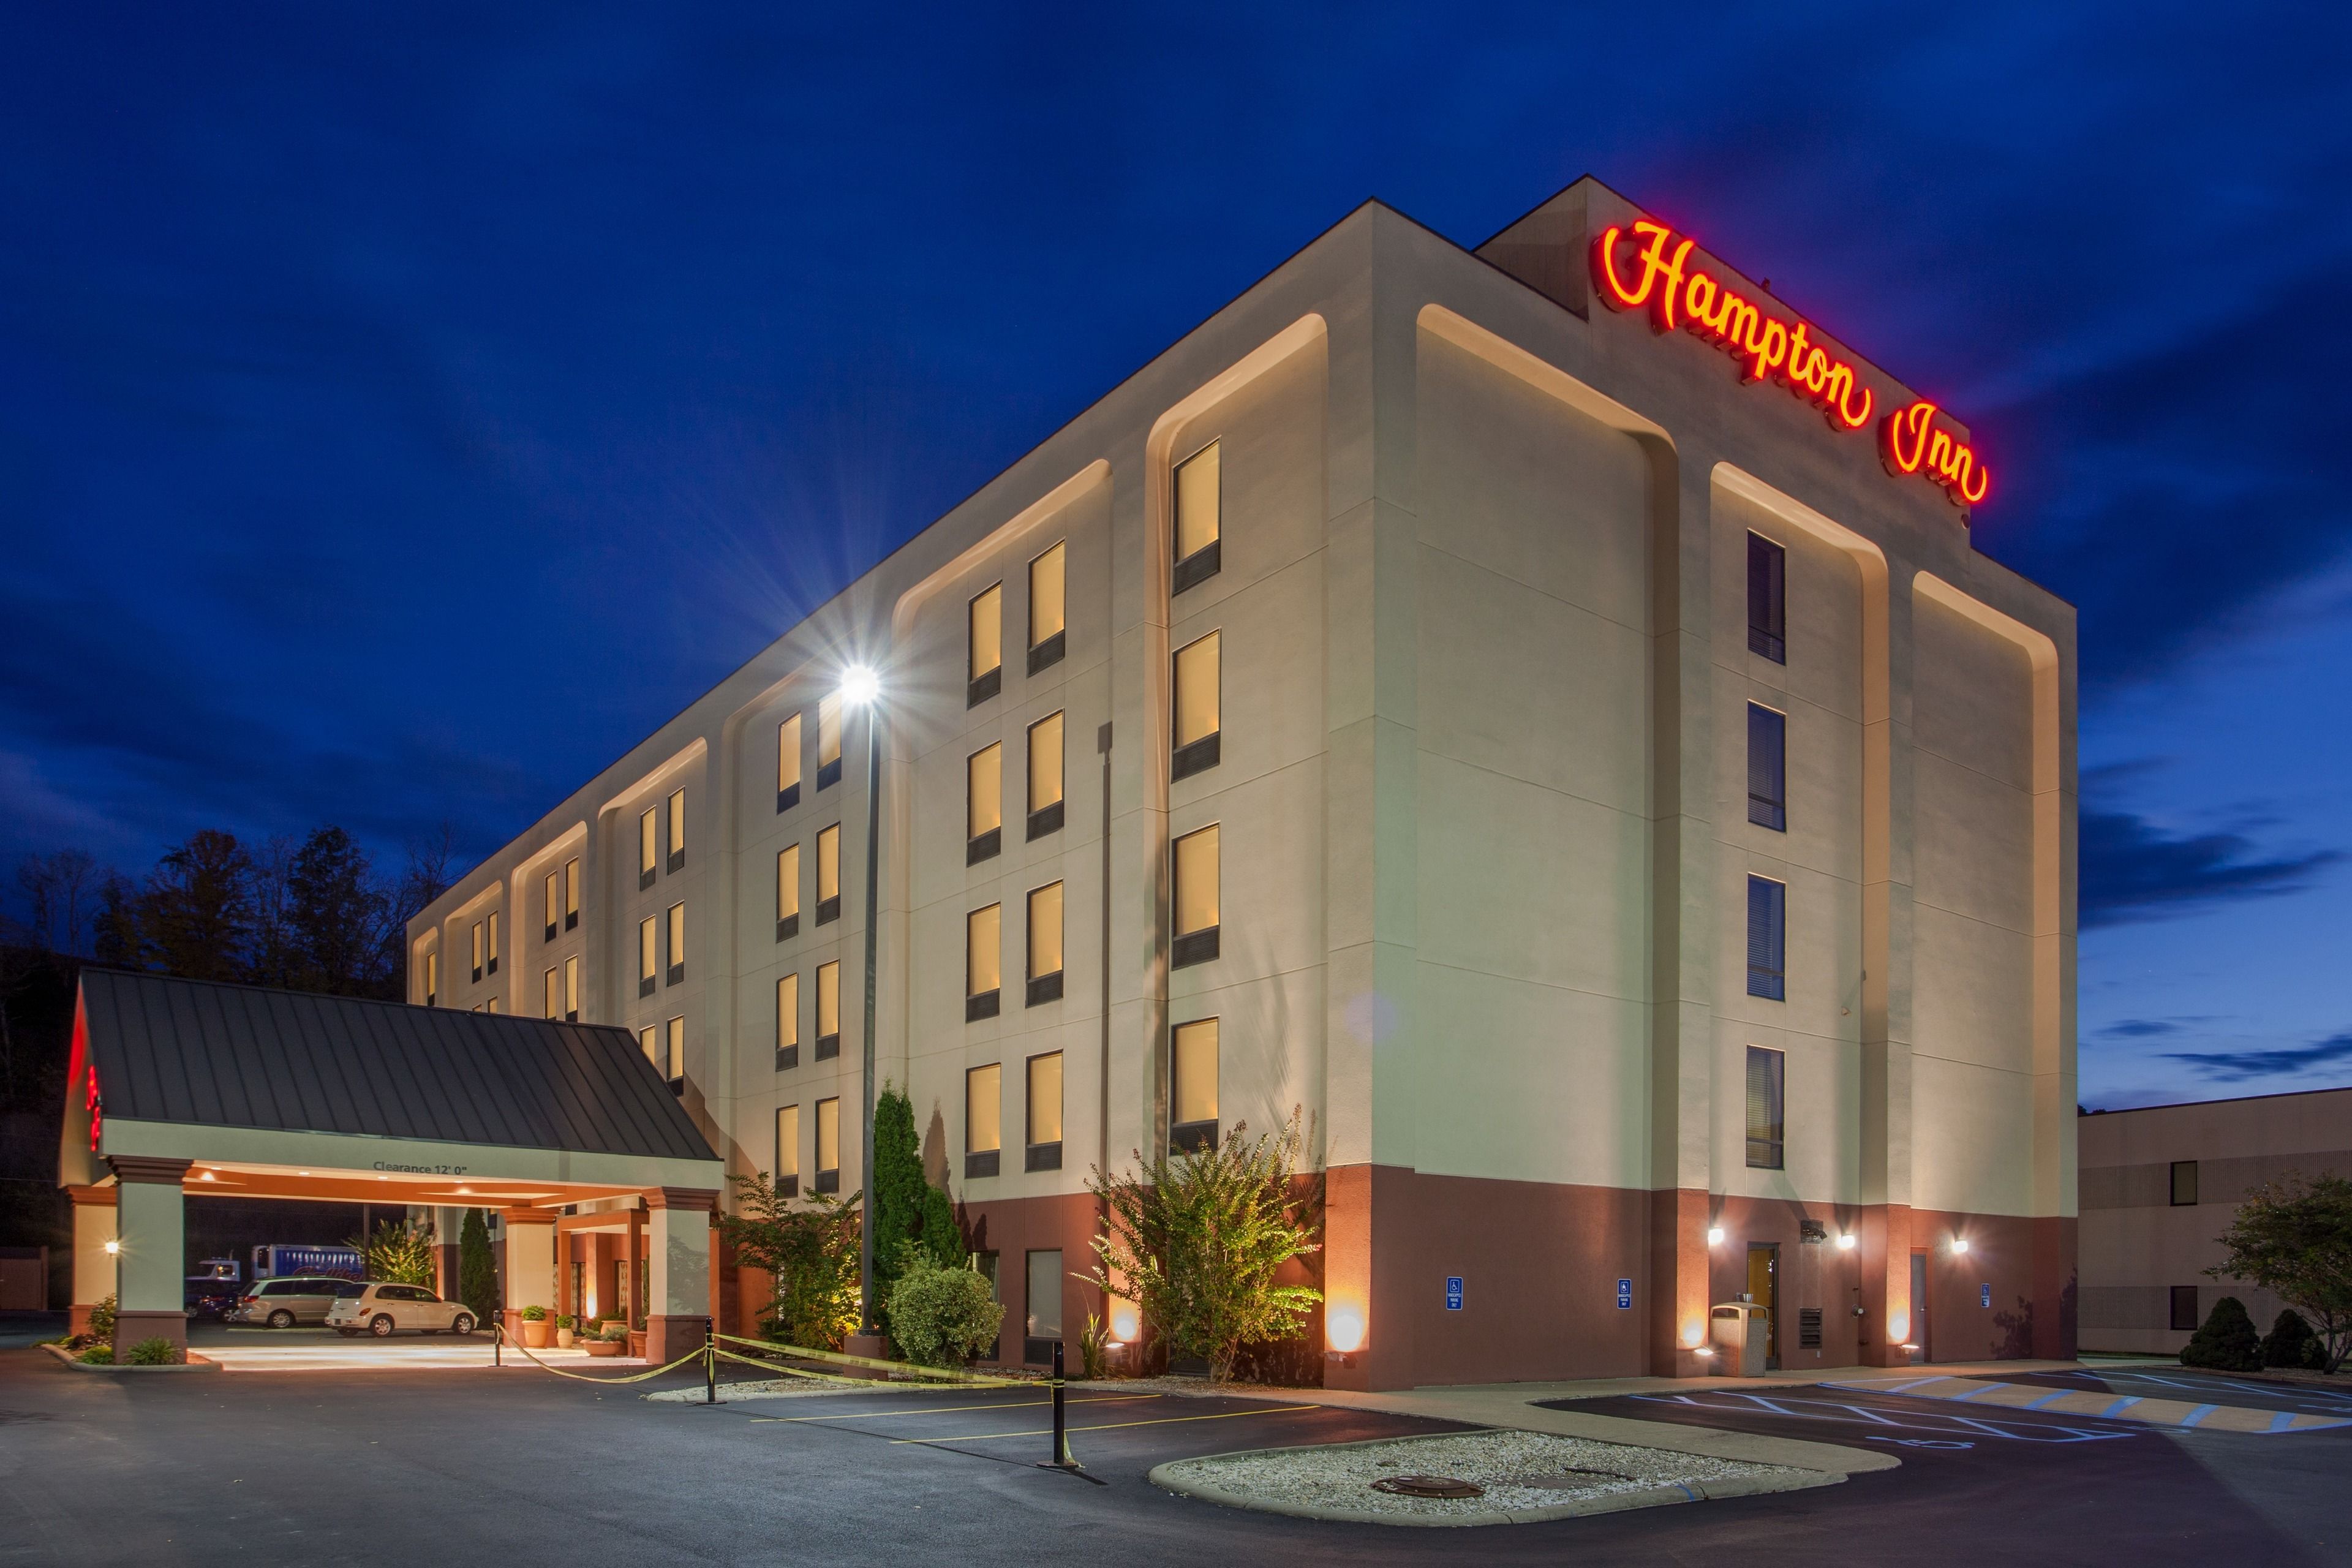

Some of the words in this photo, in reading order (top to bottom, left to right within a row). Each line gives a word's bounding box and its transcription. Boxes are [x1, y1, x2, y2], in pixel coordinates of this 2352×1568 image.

[1602, 221, 1872, 428] Hampton
[1892, 401, 1987, 502] Inn
[373, 1161, 431, 1174] Clearance
[434, 1166, 450, 1174] 12'
[454, 1166, 467, 1175] 0"
